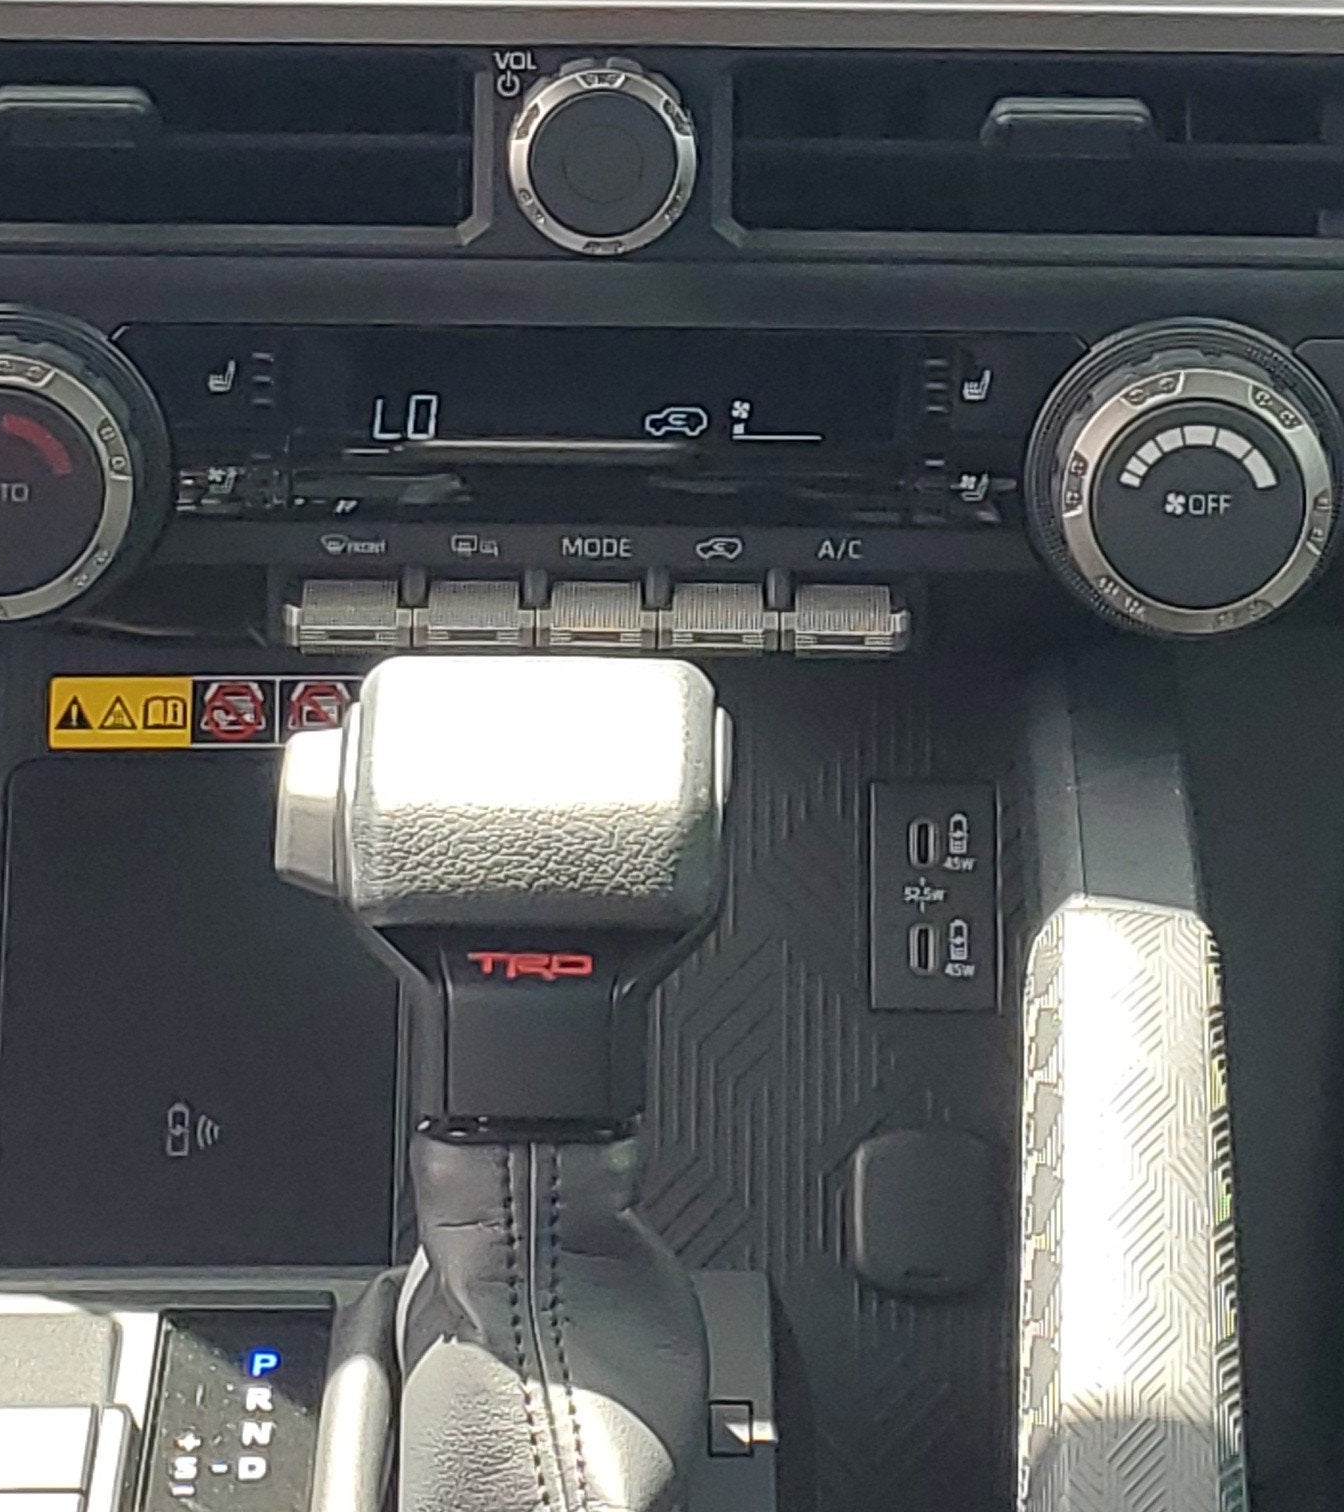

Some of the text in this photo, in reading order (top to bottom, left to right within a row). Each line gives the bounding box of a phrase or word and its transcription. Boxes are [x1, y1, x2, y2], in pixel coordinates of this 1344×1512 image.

[492, 50, 538, 70] VOL
[372, 394, 439, 441] LO
[1188, 493, 1233, 516] OFF
[561, 537, 633, 558] MODE
[816, 539, 864, 561] A/C
[466, 951, 594, 981] TRD
[251, 1352, 278, 1378] P
[245, 1386, 274, 1412] R
[241, 1420, 274, 1447] N
[173, 1455, 268, 1481] S D
